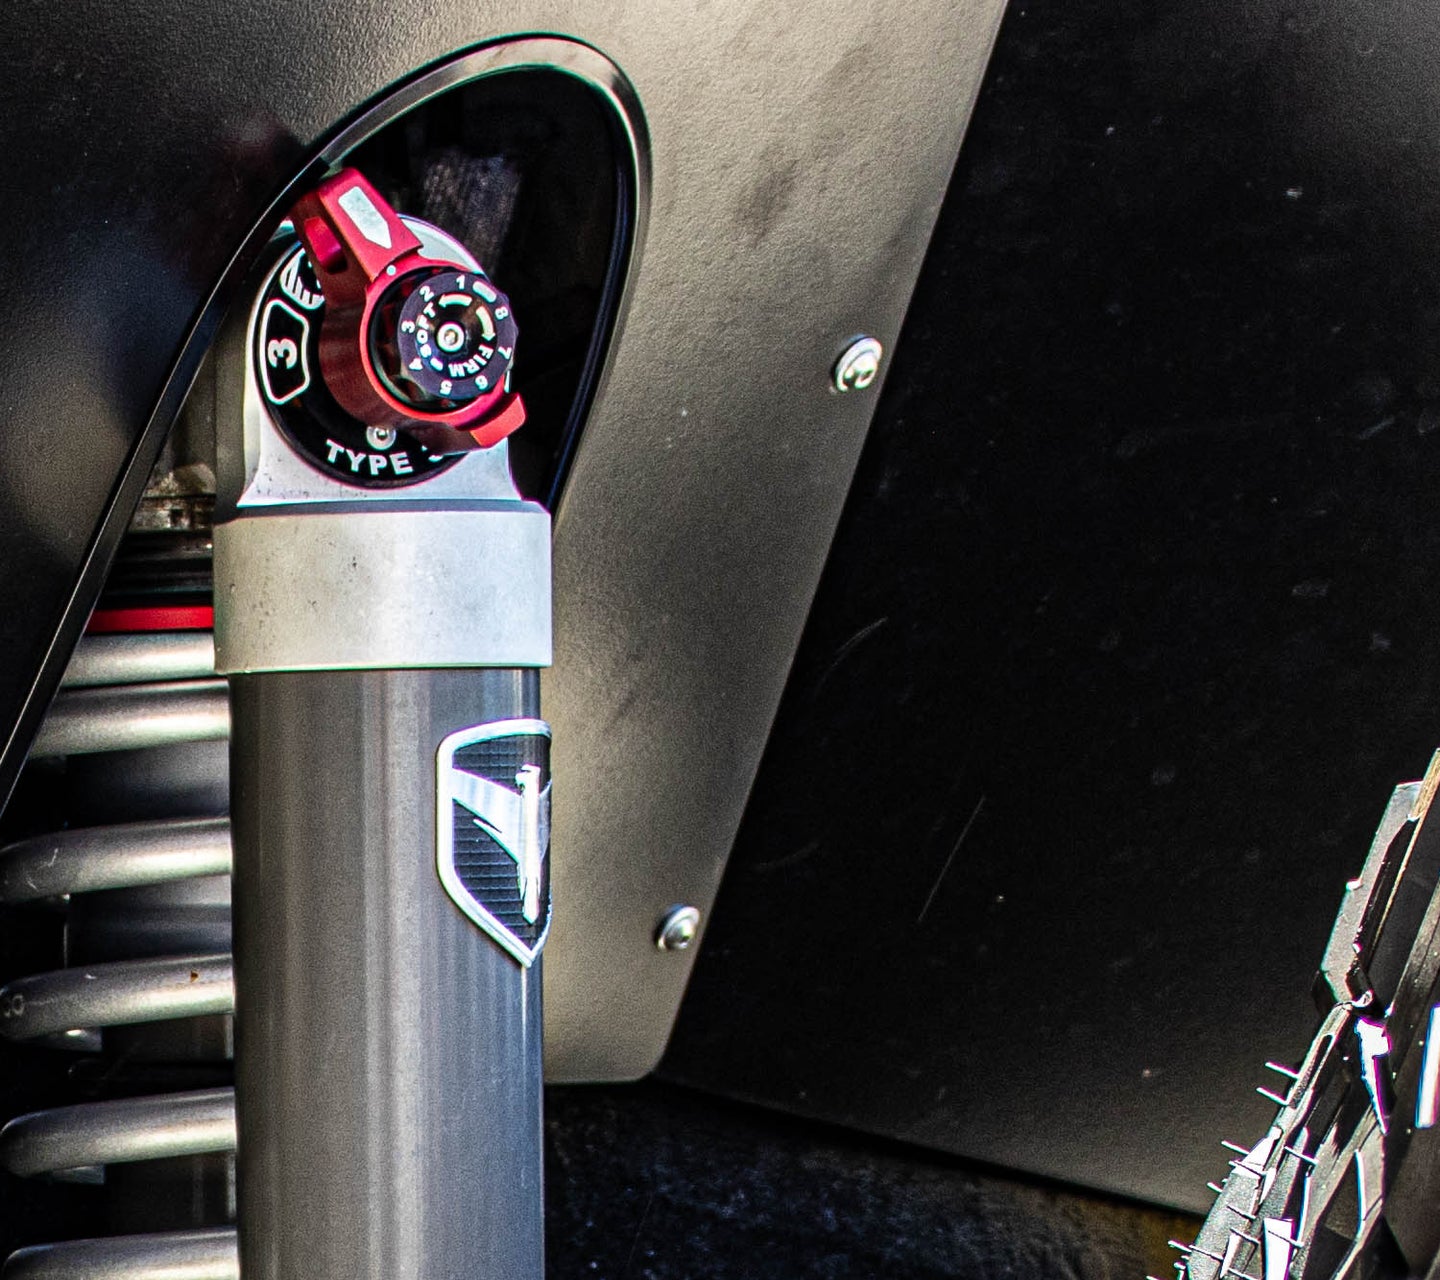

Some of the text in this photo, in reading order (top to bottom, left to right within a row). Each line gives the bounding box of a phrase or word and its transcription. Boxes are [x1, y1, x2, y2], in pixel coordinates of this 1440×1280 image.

[456, 274, 466, 290] 1
[419, 285, 435, 302] 2
[494, 306, 509, 320] 8
[401, 320, 416, 334] 3
[416, 301, 436, 358] SOFT
[267, 338, 298, 370] 3
[448, 344, 494, 378] FIRM
[497, 346, 513, 360] 7
[440, 380, 453, 396] 5
[326, 438, 414, 475] TYPE
